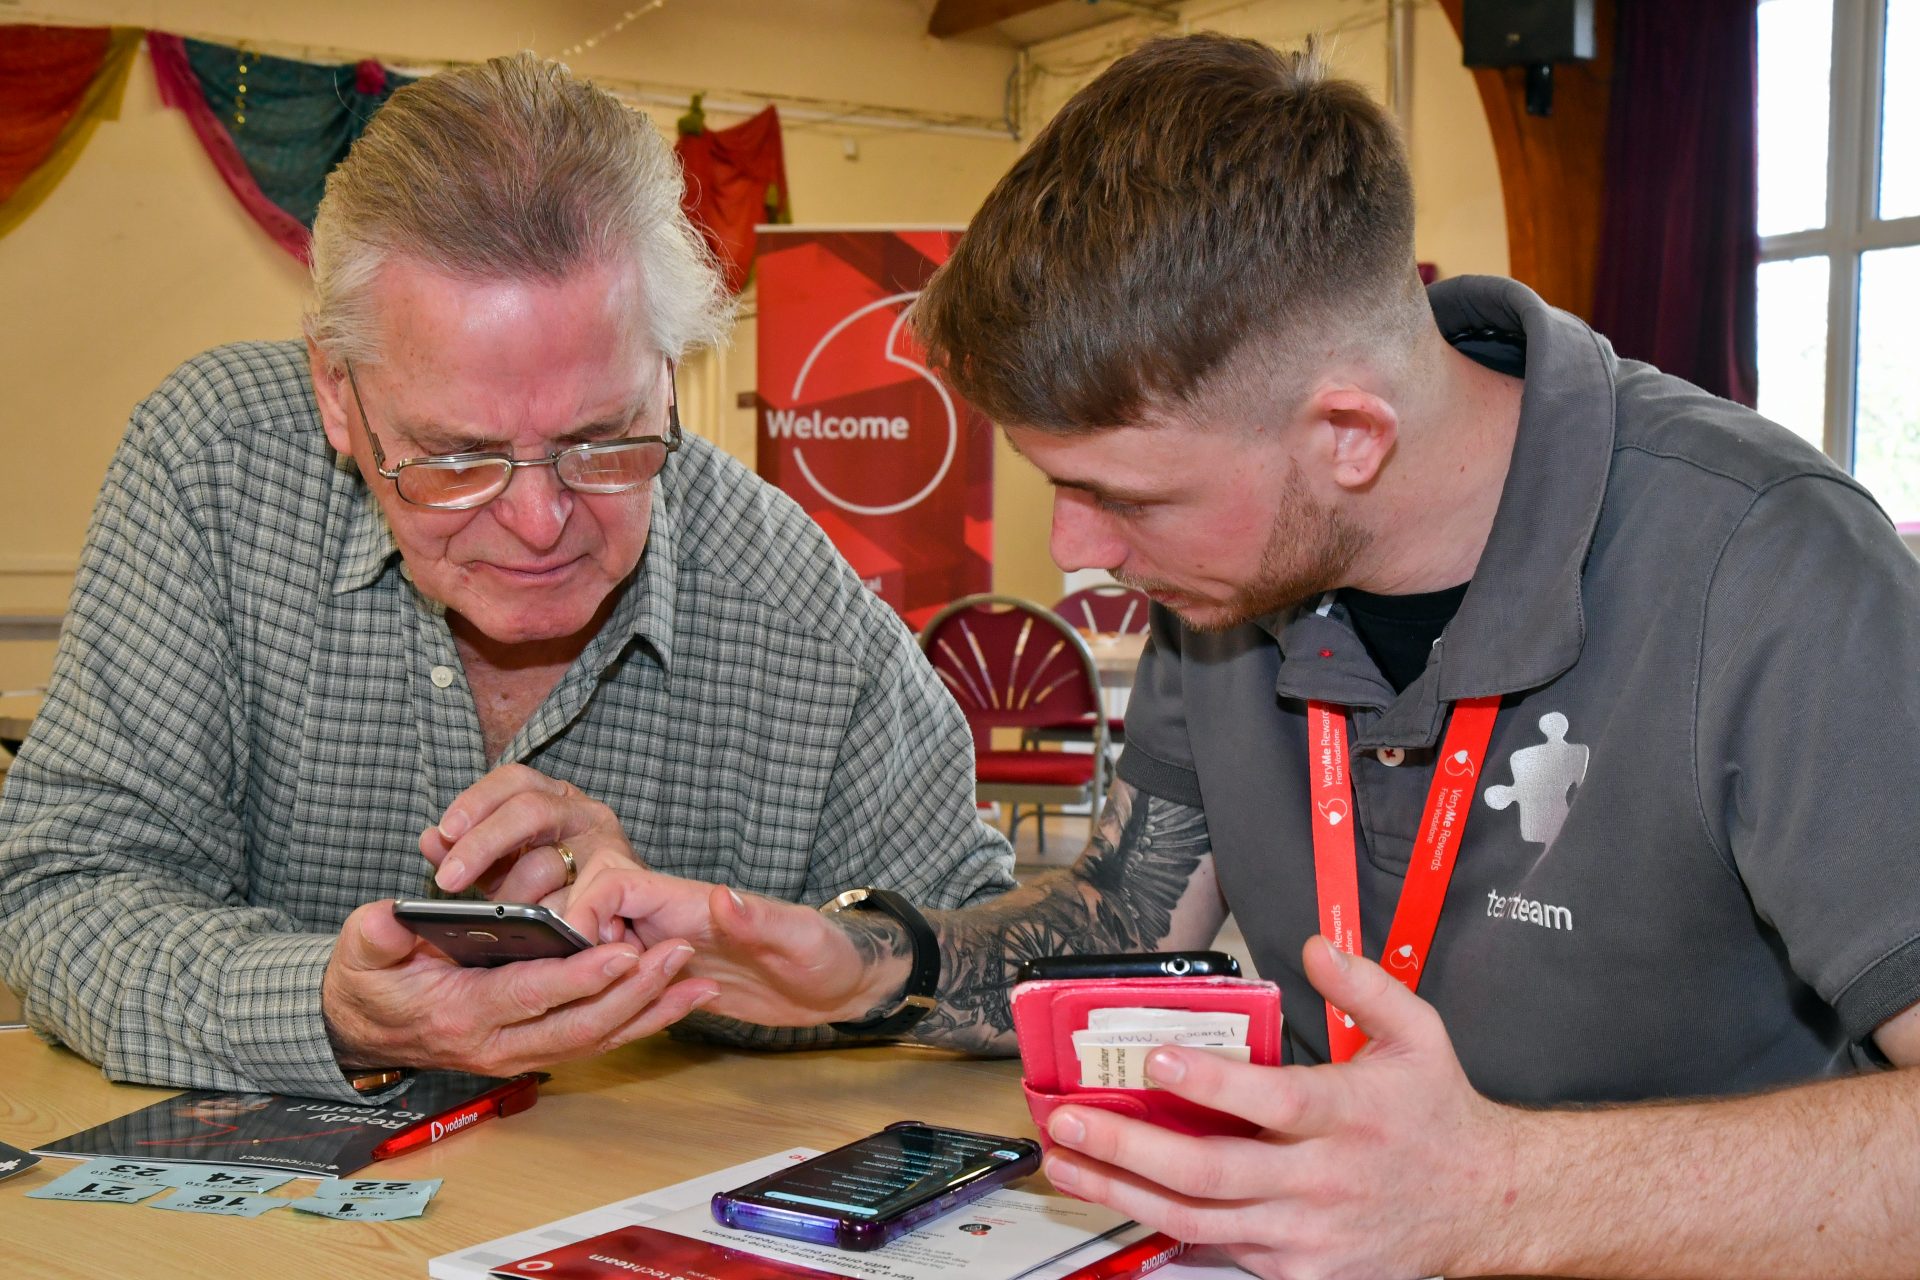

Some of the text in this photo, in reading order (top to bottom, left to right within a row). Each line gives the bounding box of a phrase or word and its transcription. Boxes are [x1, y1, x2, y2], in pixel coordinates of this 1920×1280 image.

[766, 410, 909, 439] Welcome
[1333, 728, 1343, 785] From Vodafone
[1322, 748, 1335, 788] VeryMe
[1427, 787, 1448, 844] From Vodafone
[1431, 789, 1463, 871] VeryMe Rewards
[1331, 904, 1343, 948] Rewards
[1116, 1048, 1126, 1064] trust
[1118, 1063, 1126, 1077] can
[286, 1104, 426, 1121] to learn?
[307, 1112, 408, 1130] Ready
[444, 1112, 479, 1134] vodafone
[239, 1155, 327, 1168] techconnect
[110, 1164, 168, 1177] 23
[206, 1172, 264, 1184] 24
[77, 1183, 136, 1196] 21
[352, 1182, 412, 1191] 22
[193, 1195, 247, 1207] 16
[338, 1203, 357, 1213] 1
[702, 1229, 748, 1243] session
[588, 1253, 670, 1279] techteam
